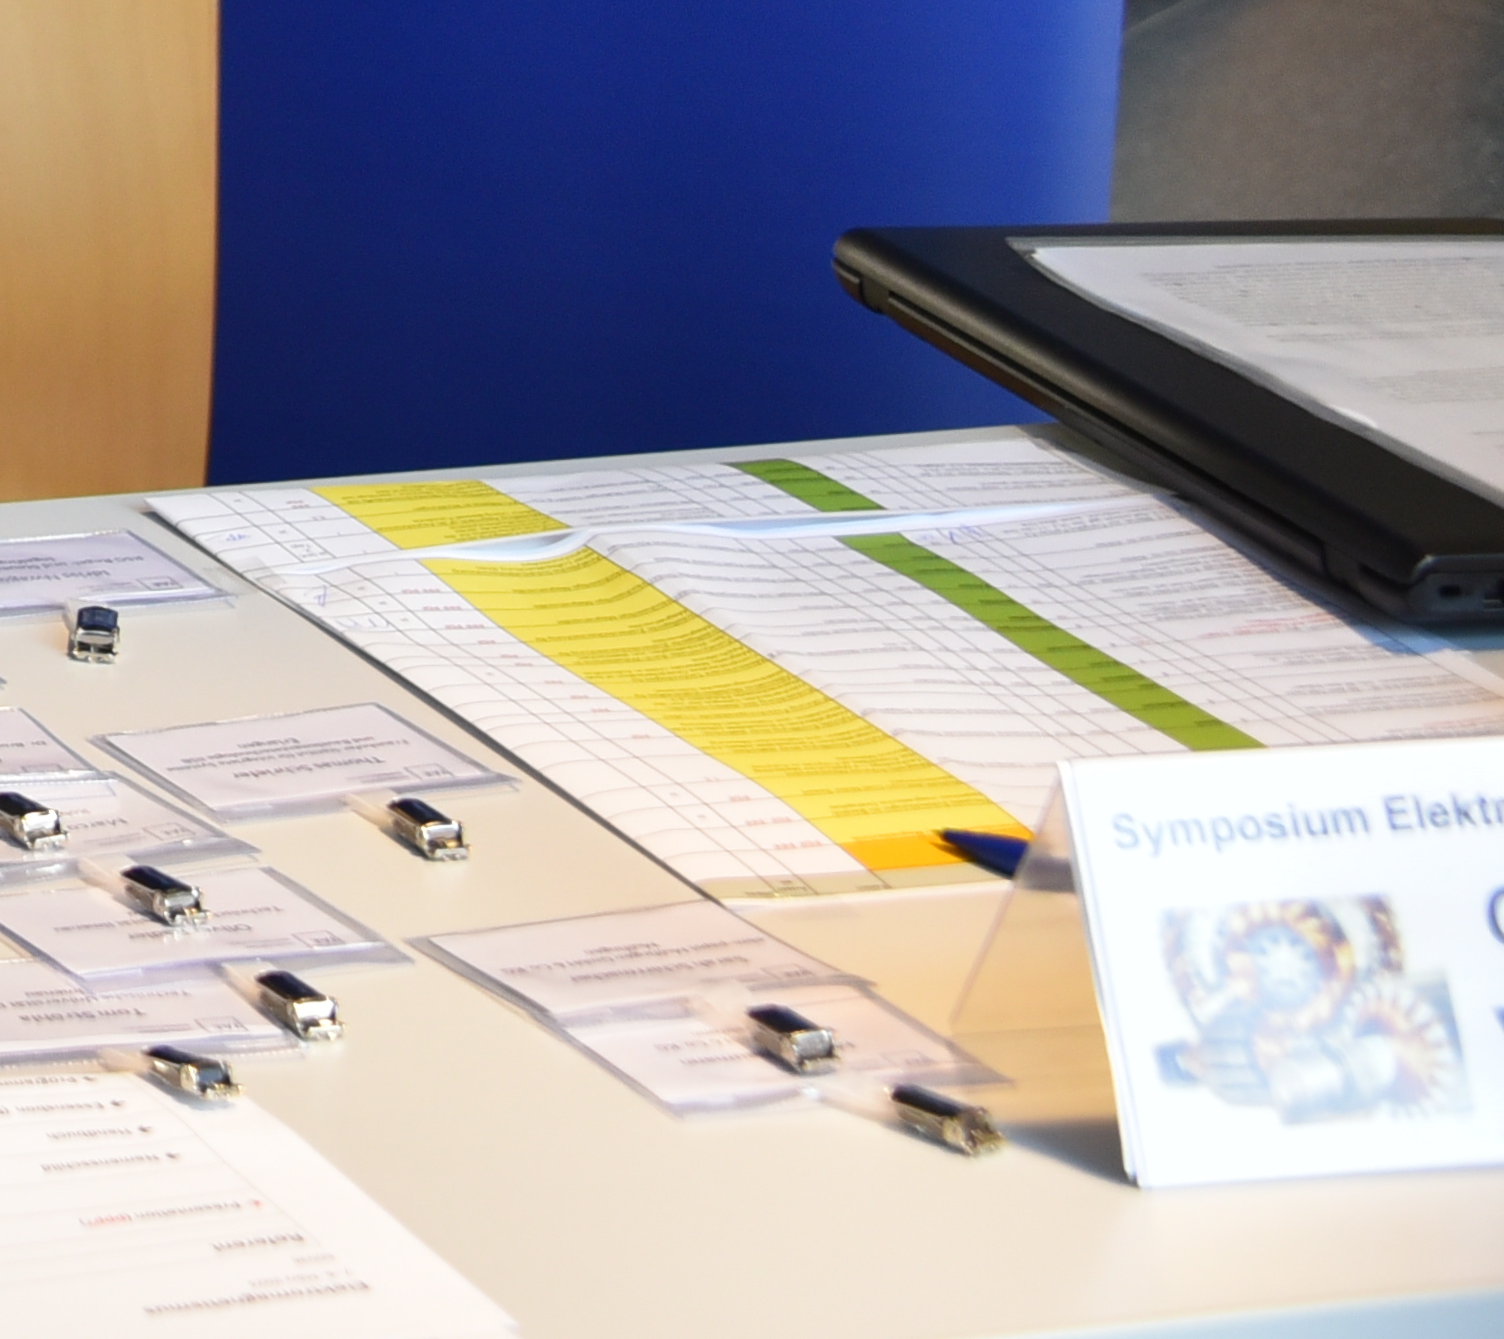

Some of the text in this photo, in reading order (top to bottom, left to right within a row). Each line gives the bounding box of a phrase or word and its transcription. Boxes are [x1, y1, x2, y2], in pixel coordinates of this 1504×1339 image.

[317, 754, 386, 769] Thomas
[1111, 801, 1371, 857] Symposium
[18, 1007, 147, 1025] Tom Ströhla
[14, 1099, 105, 1117] Essensbon
[44, 1126, 132, 1143] Handbuch
[40, 1152, 161, 1174] Namensschild
[211, 1232, 307, 1254] Referent
[144, 1282, 371, 1319] Elektromagnetismus
